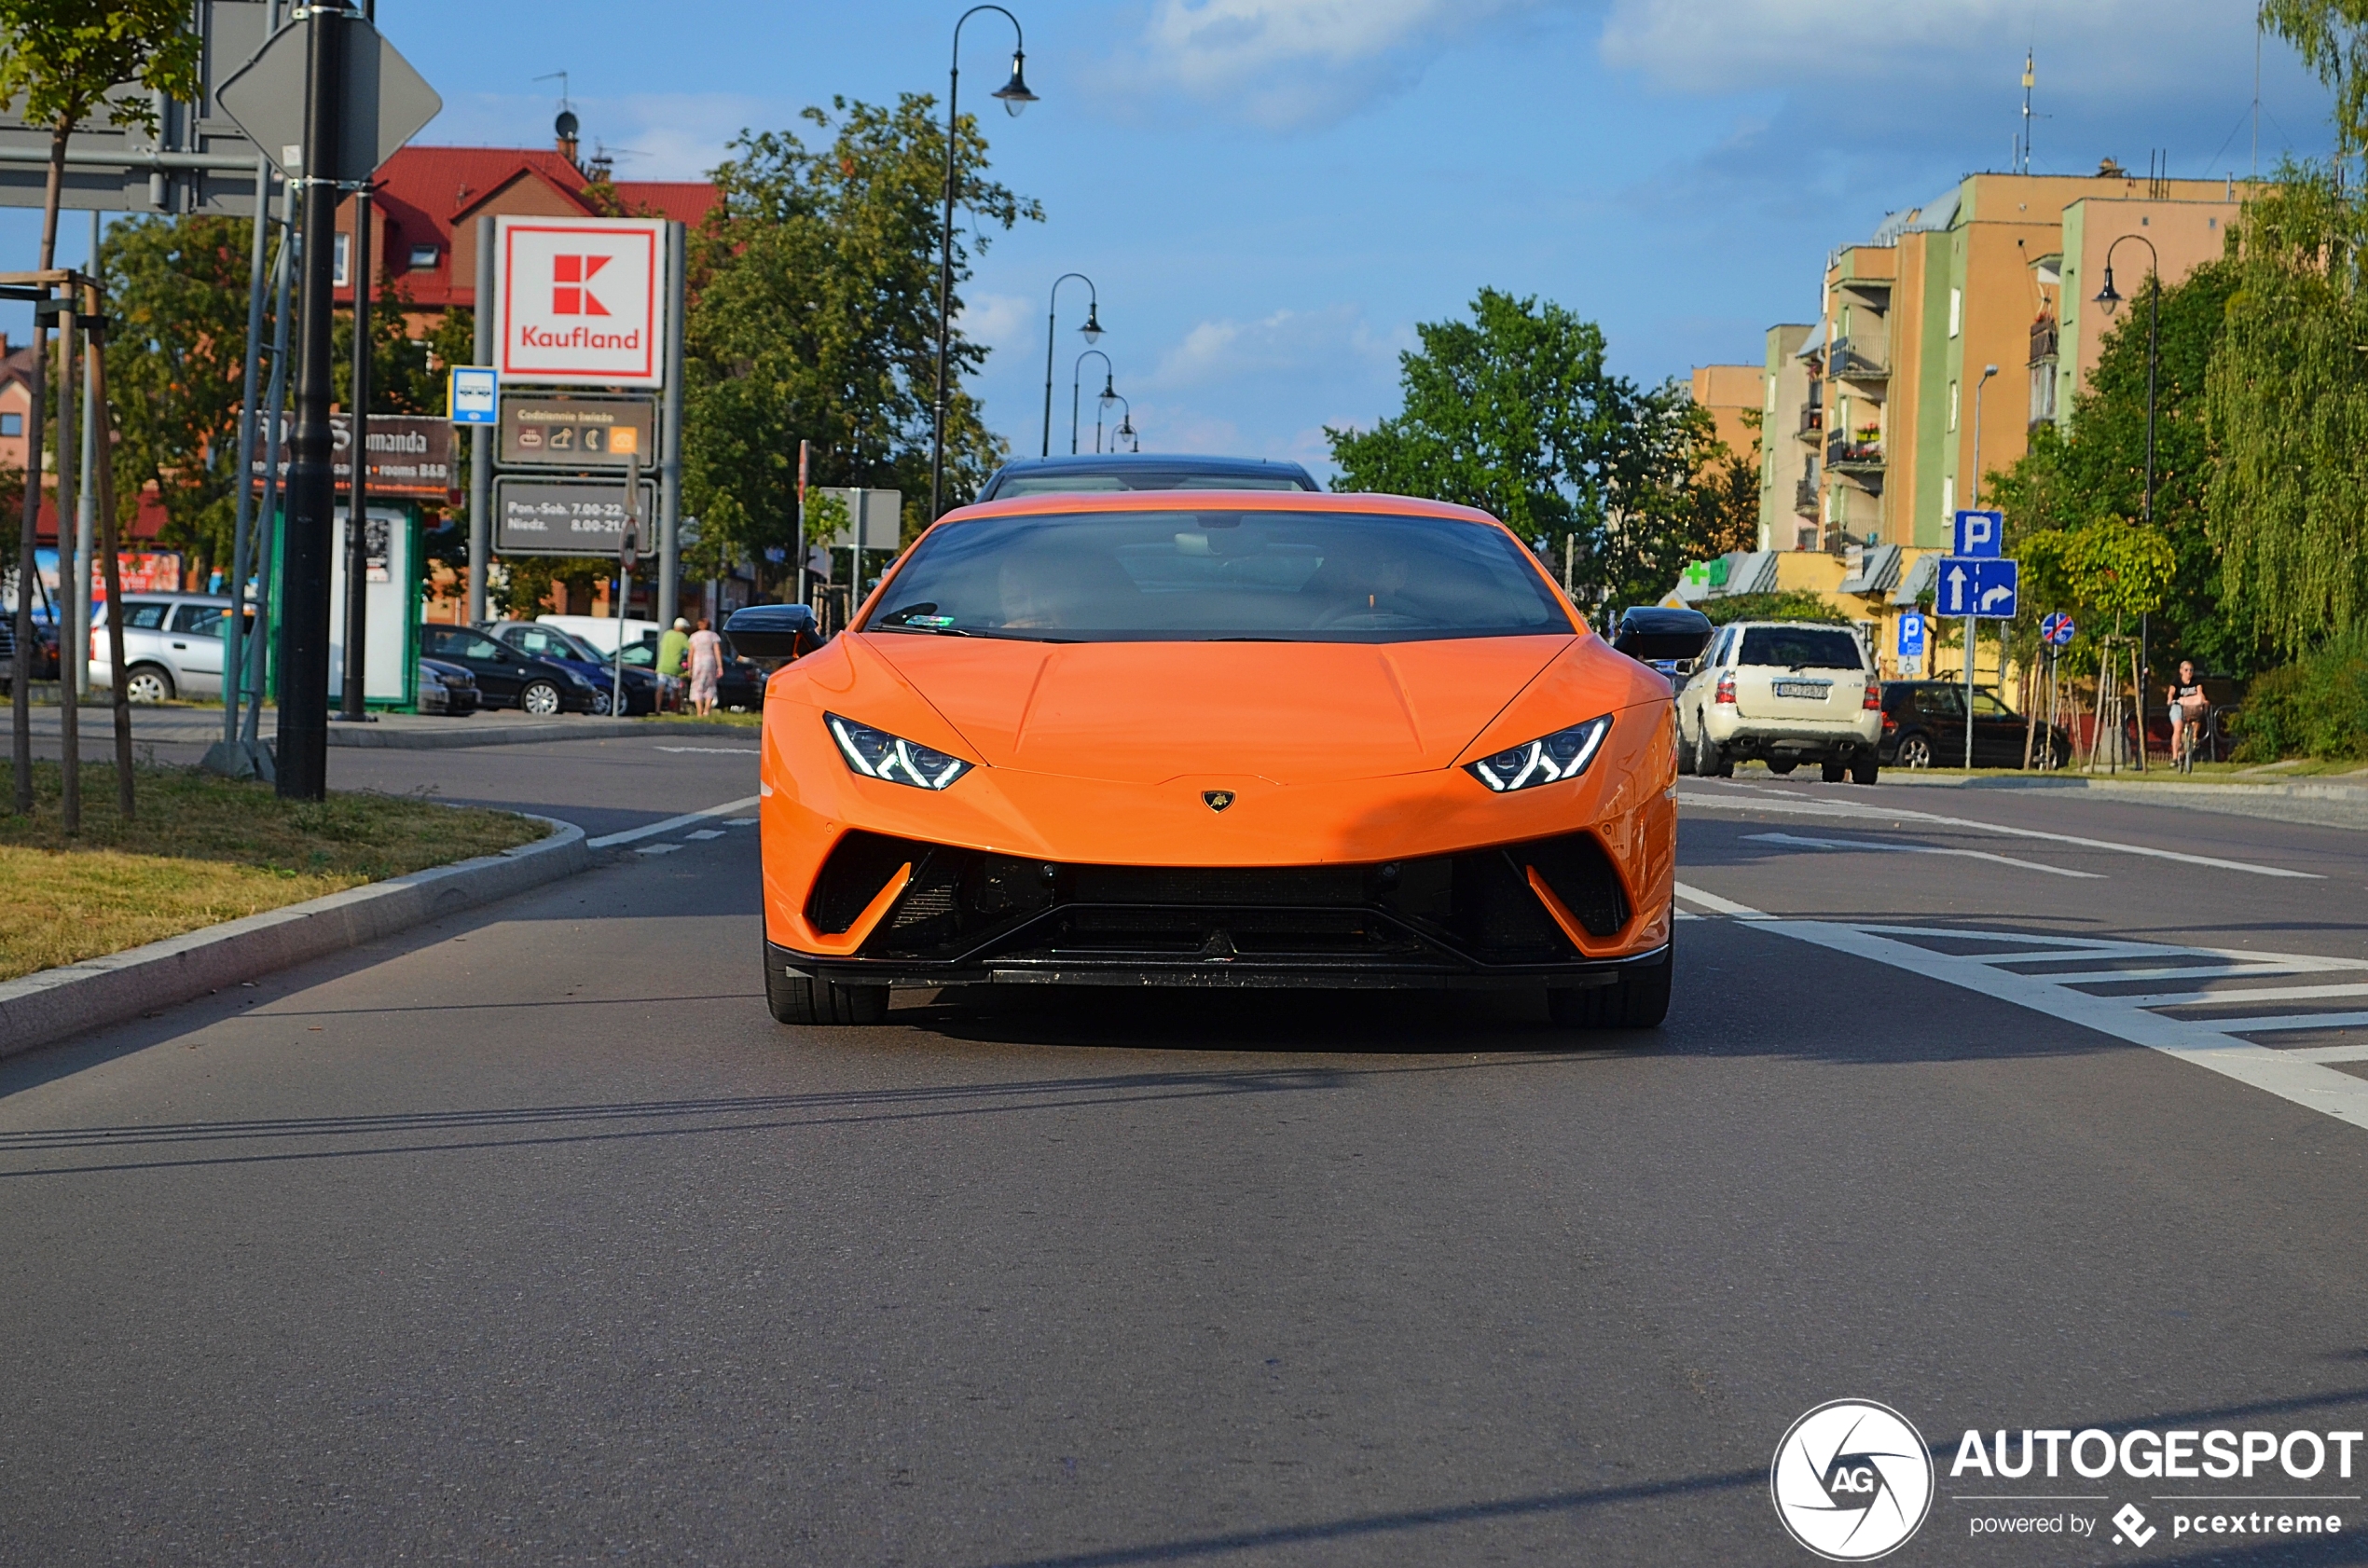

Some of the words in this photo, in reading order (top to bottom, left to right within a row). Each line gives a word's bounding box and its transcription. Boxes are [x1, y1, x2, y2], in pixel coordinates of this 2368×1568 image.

[521, 325, 640, 350] Kaufland
[419, 463, 447, 478] B&B
[507, 517, 548, 531] Niedz.
[1964, 516, 1991, 553] P
[1903, 617, 1920, 643] P
